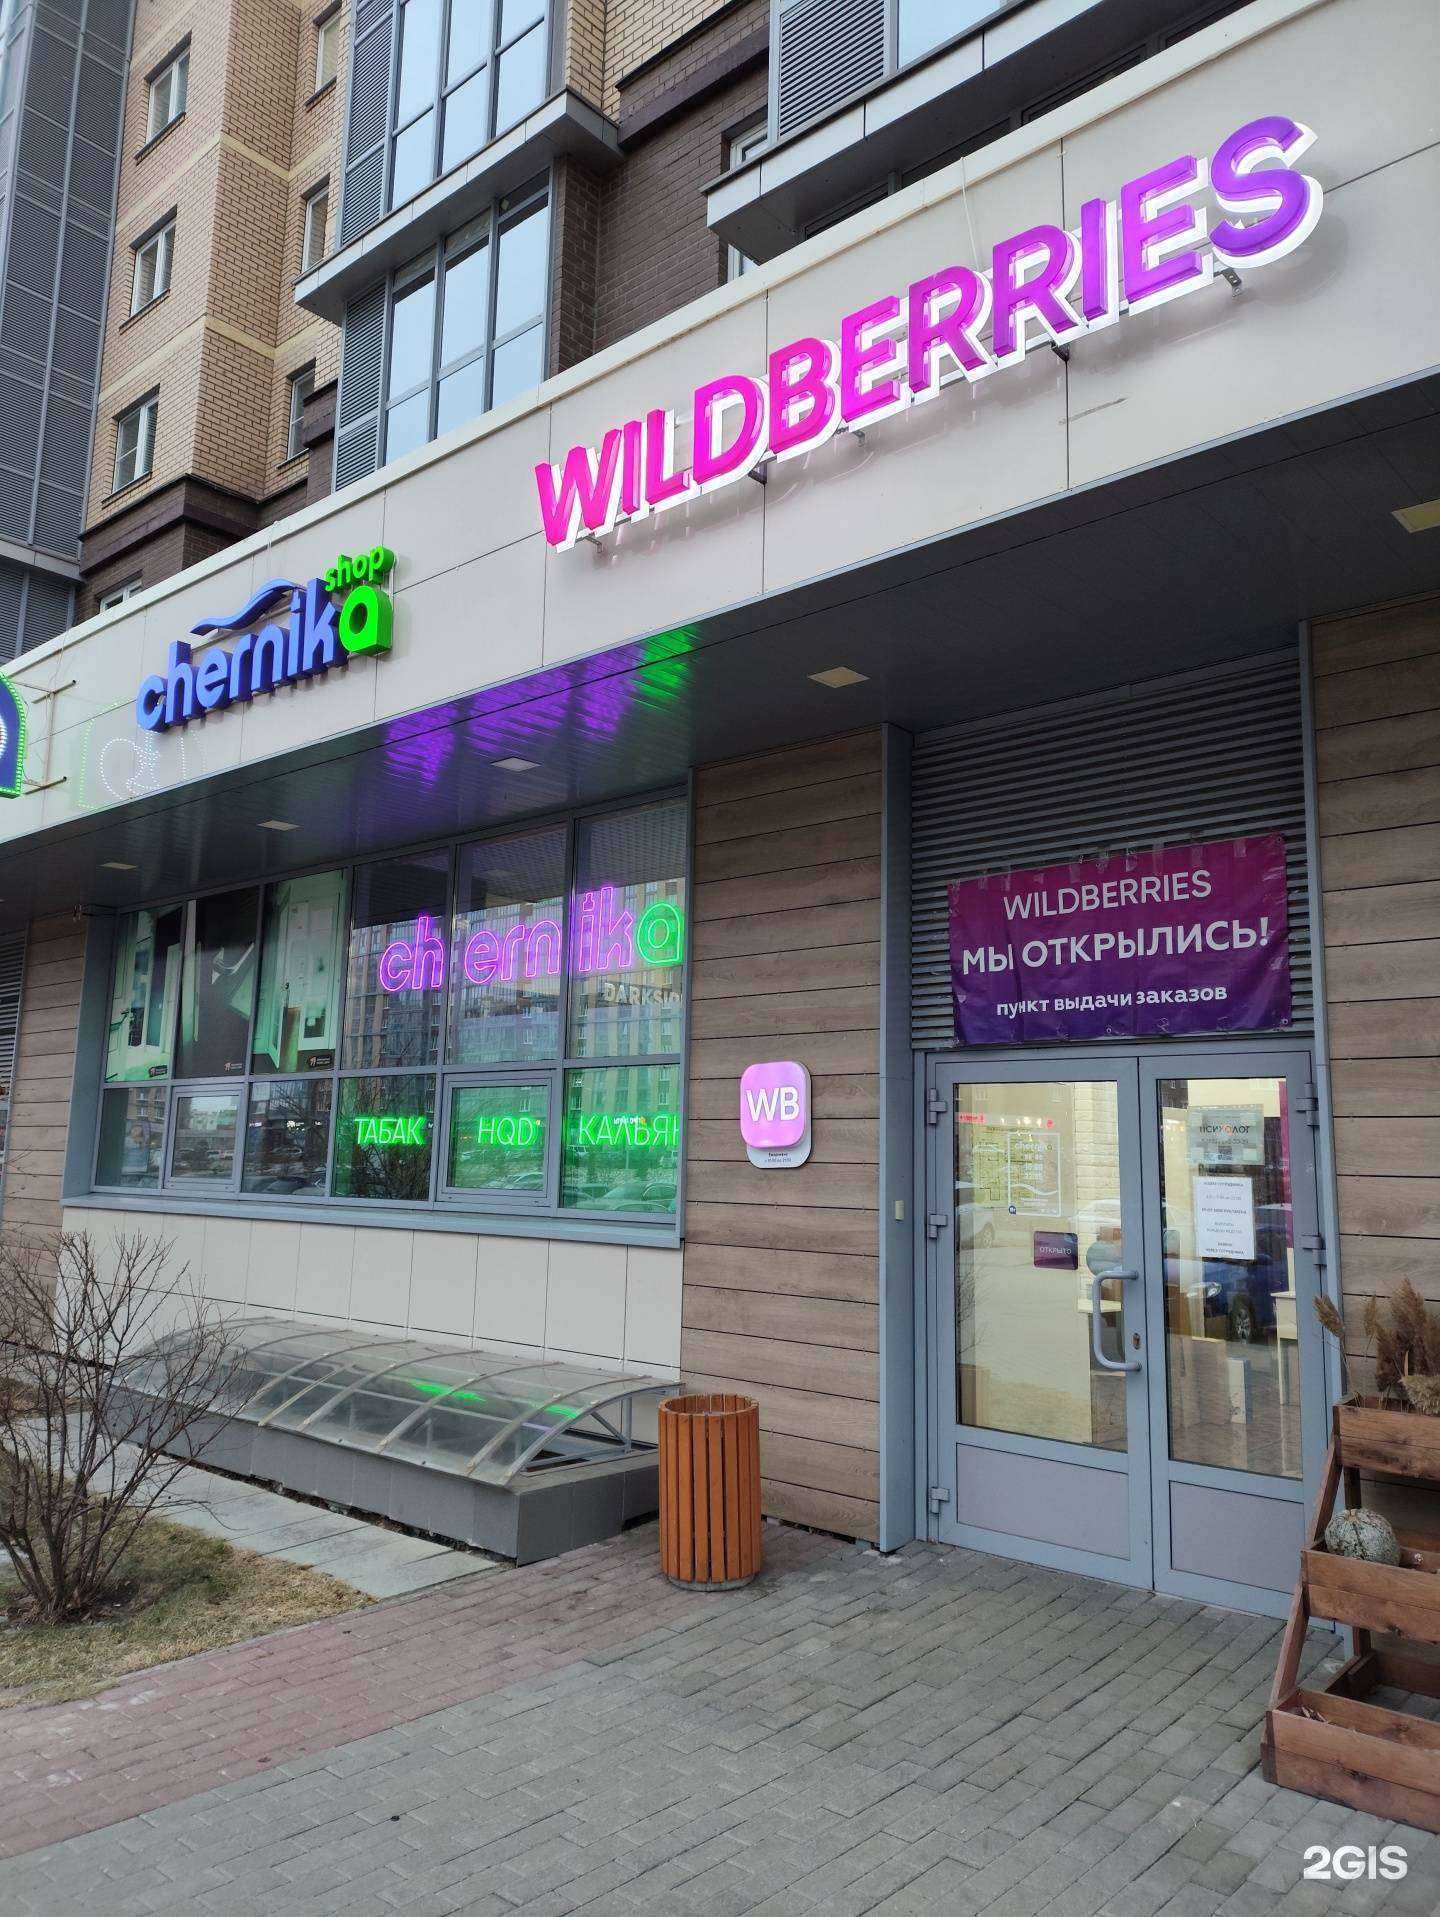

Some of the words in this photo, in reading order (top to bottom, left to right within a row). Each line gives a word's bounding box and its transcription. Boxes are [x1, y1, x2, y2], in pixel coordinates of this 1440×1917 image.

[534, 115, 1324, 553] WILDBERRIES
[324, 546, 395, 591] shop
[136, 577, 394, 733] chernika
[1003, 869, 1213, 921] WILDBERRIES
[962, 943, 1014, 976] МЫ
[1022, 916, 1270, 967] ОТКРЫЛИСЬ!
[996, 998, 1050, 1020] пункт
[1054, 992, 1133, 1013] выдачи
[1136, 985, 1228, 1006] заказов
[746, 1086, 801, 1122] WB
[354, 1115, 424, 1146] ТАБАК
[477, 1116, 534, 1146] HQD
